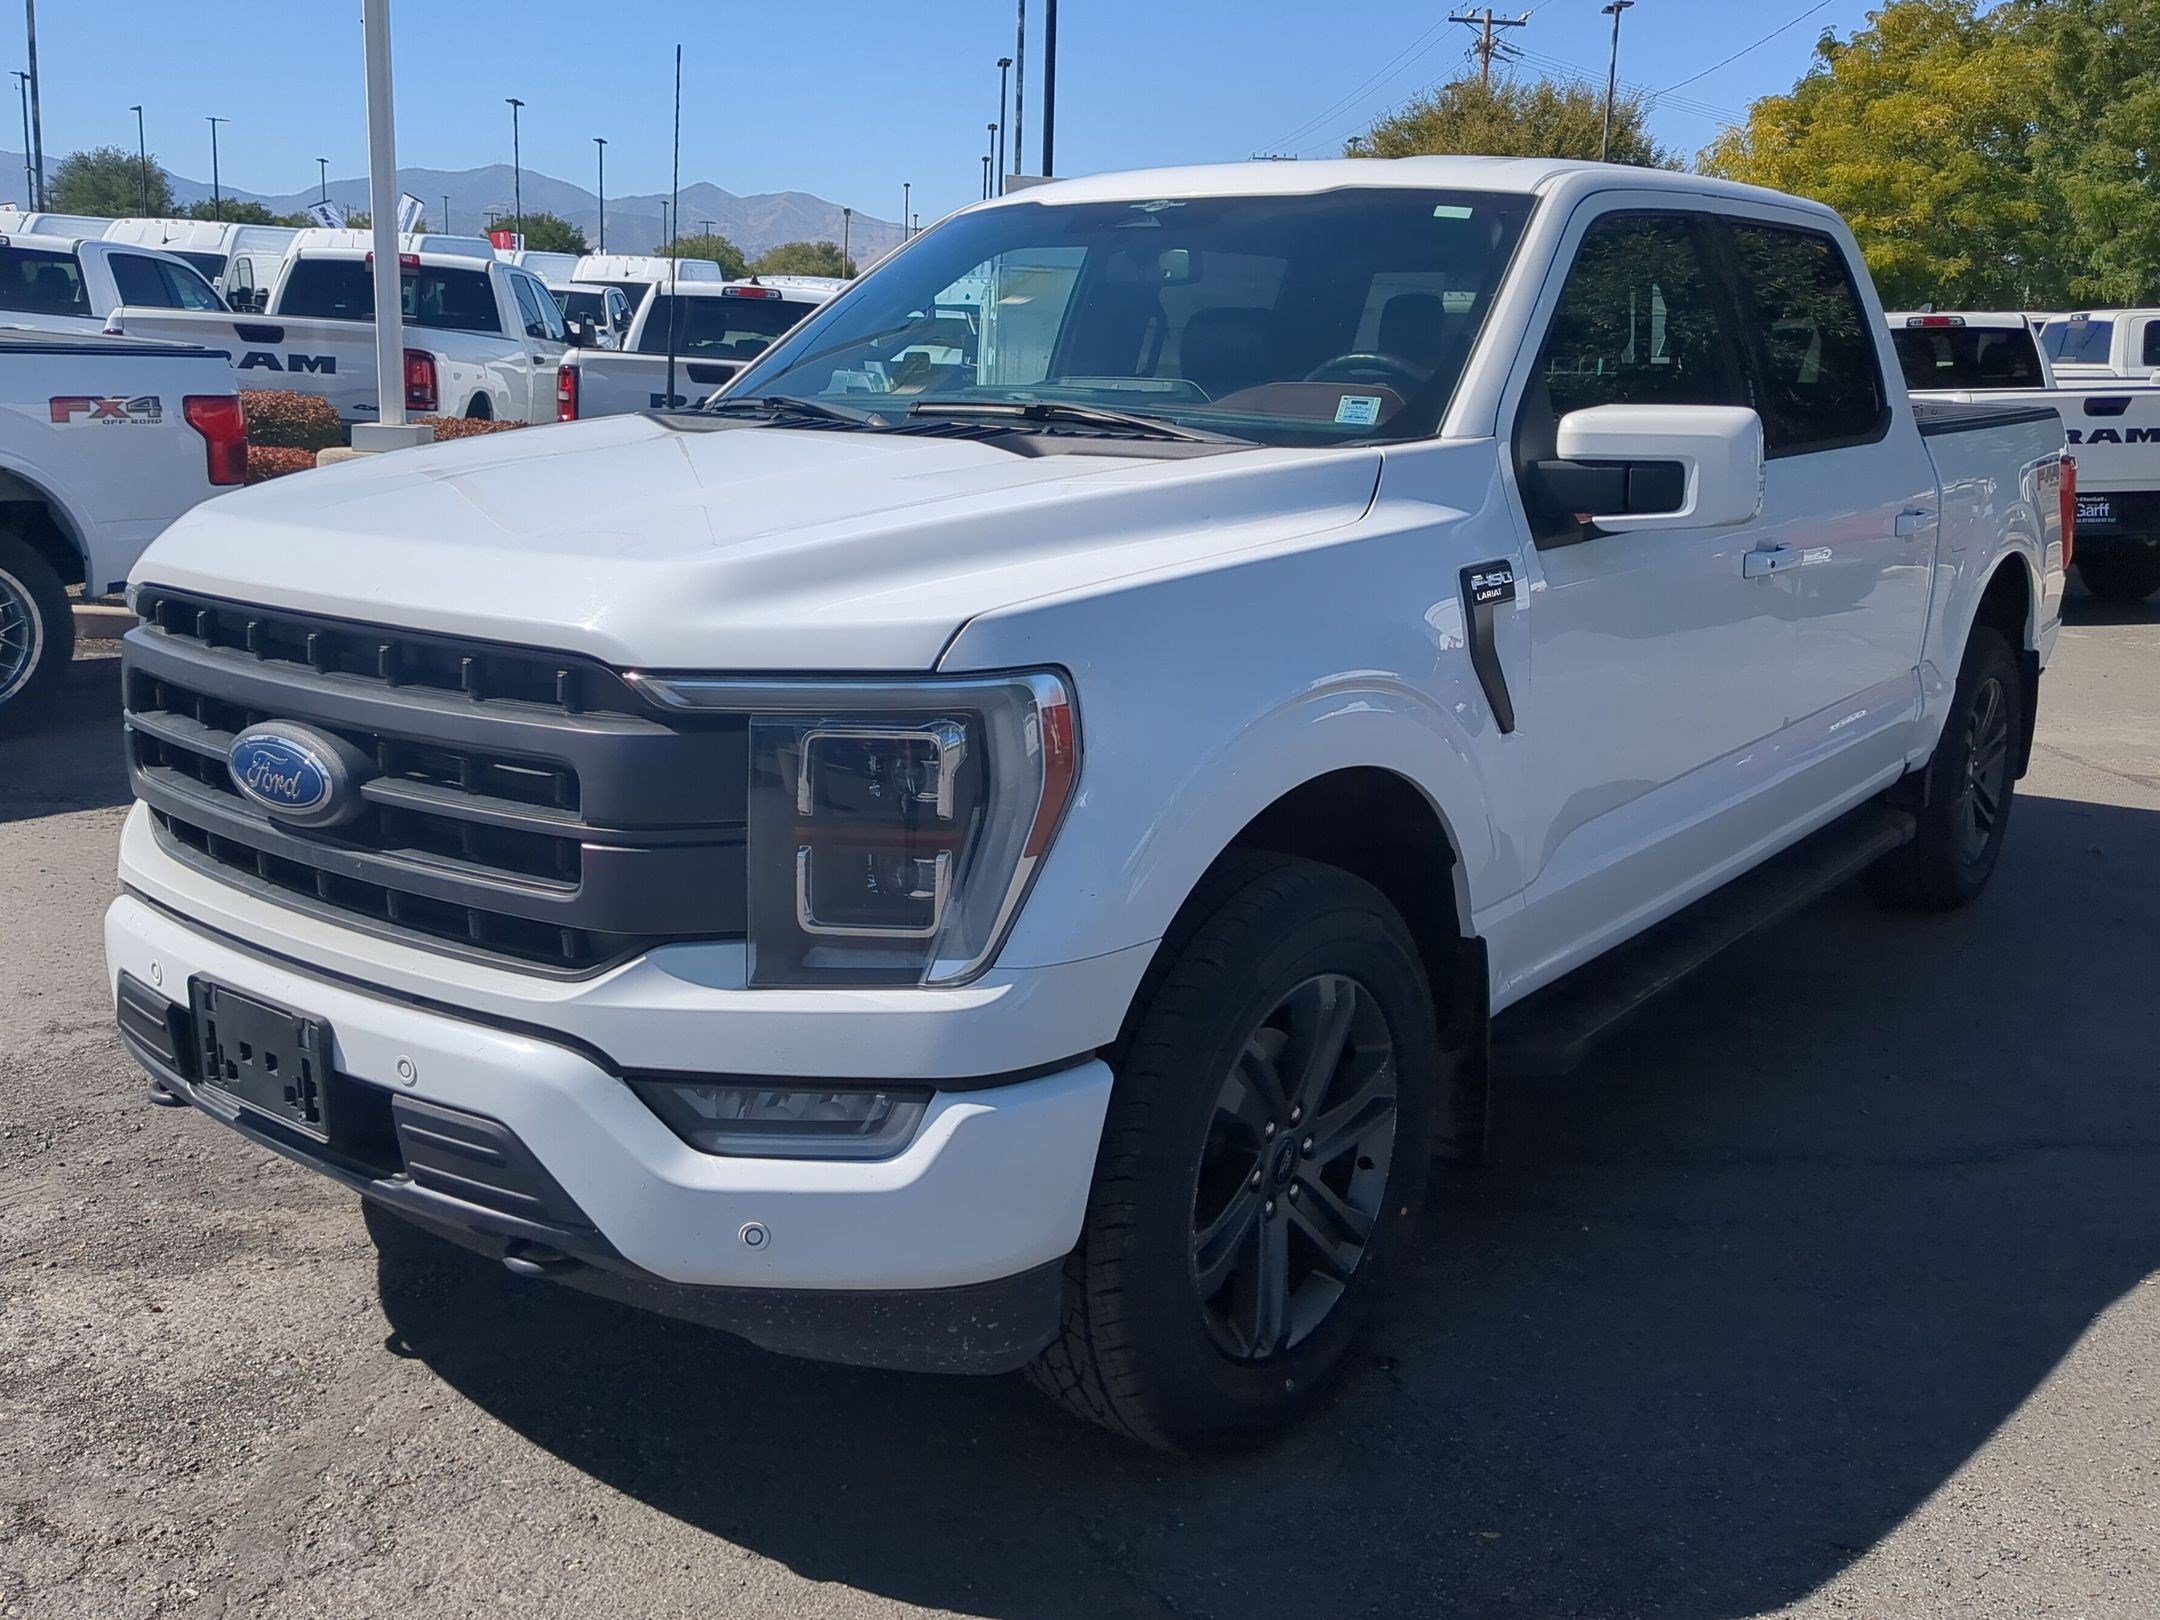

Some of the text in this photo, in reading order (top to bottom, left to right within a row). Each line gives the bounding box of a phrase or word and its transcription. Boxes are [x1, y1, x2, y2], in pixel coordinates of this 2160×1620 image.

[230, 350, 337, 375] AM
[48, 395, 163, 424] FX4
[2076, 503, 2110, 517] Garff
[1476, 587, 1503, 601] LARIAT
[246, 750, 303, 800] Ford
